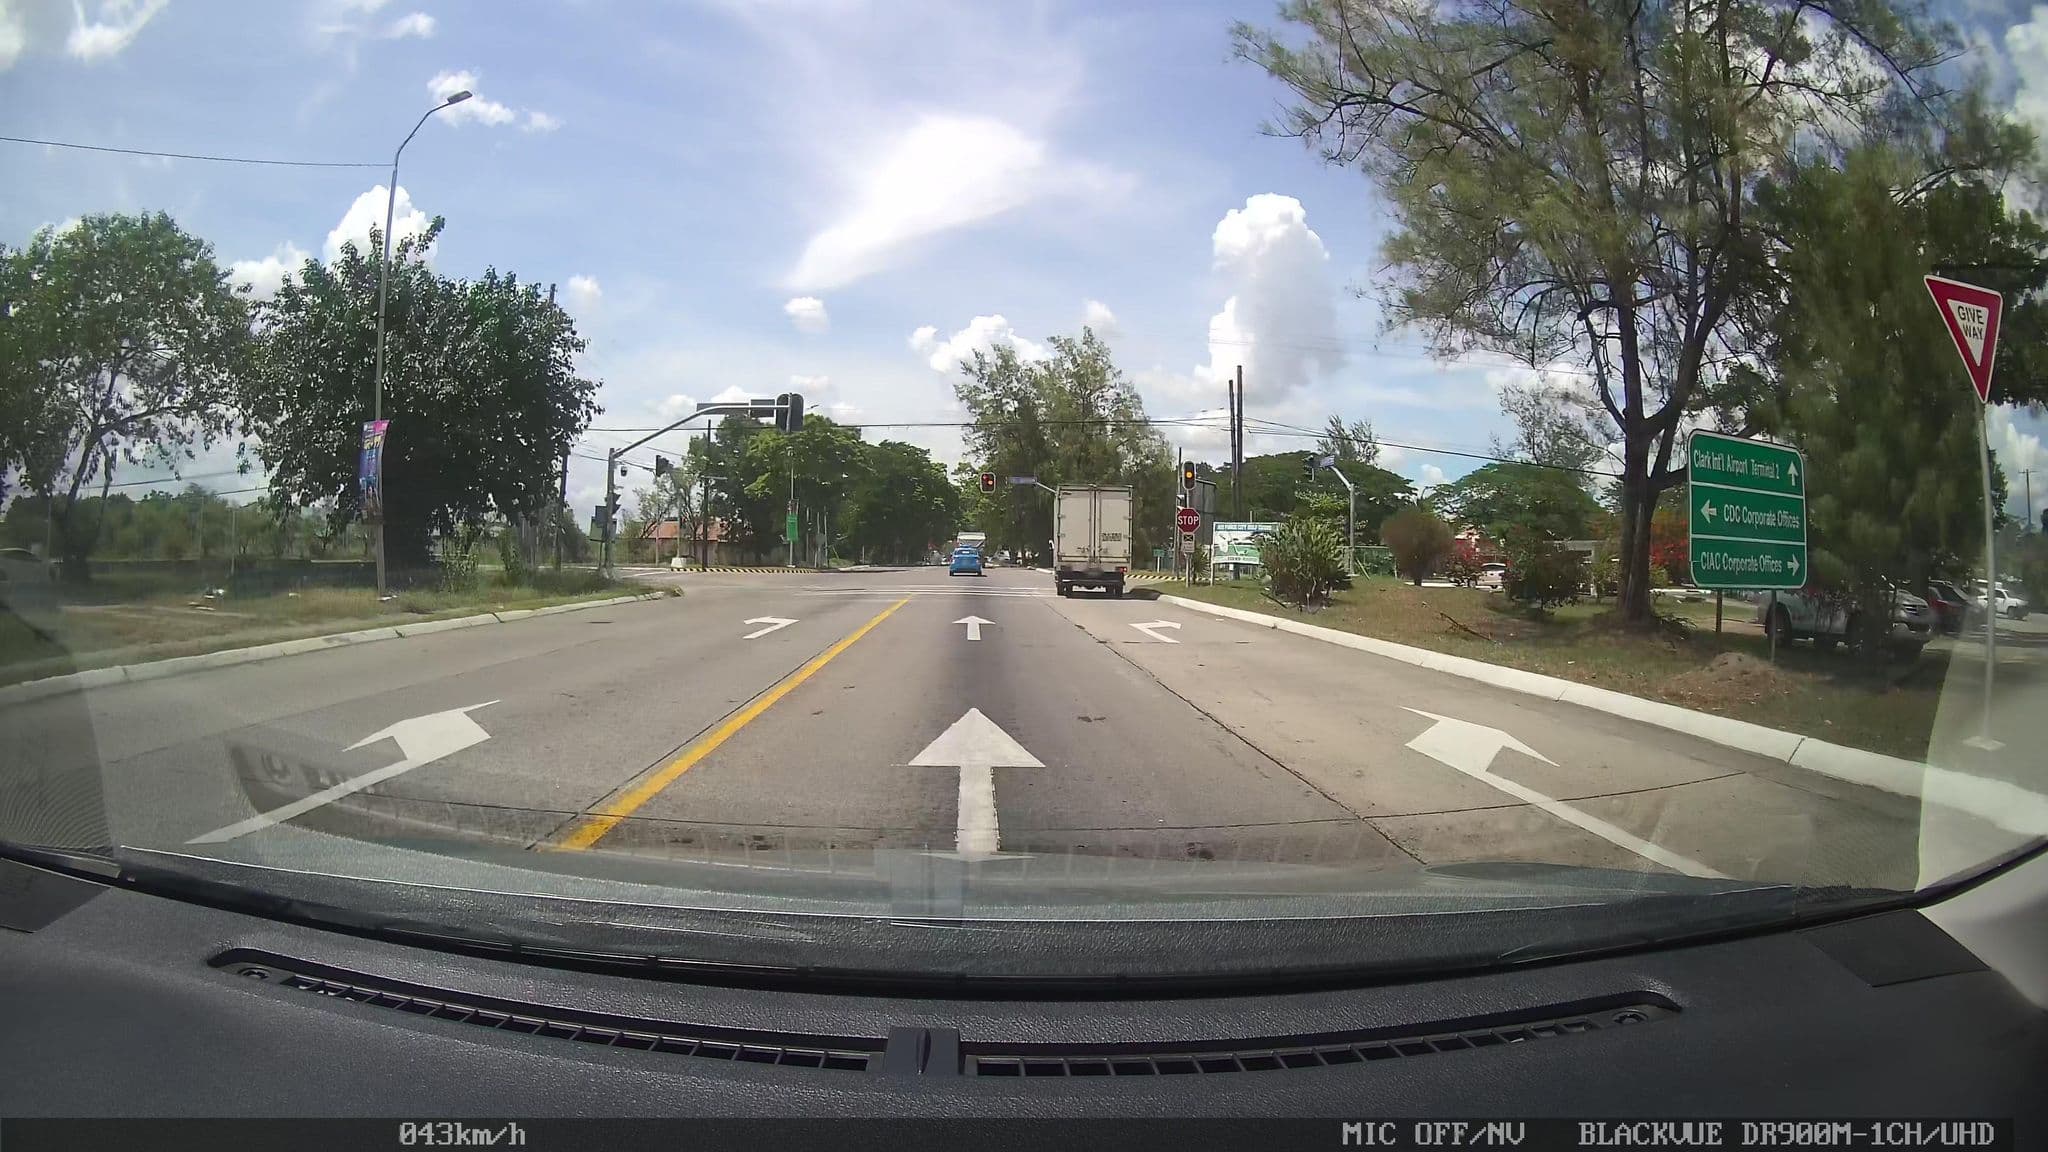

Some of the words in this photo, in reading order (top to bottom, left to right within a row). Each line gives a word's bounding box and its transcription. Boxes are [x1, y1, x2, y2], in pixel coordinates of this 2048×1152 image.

[1958, 306, 1984, 325] GIVE
[1963, 324, 1982, 340] WAY
[1693, 449, 1711, 470] Clark
[1726, 454, 1748, 475] Airport
[1750, 458, 1775, 479] Terminal
[1177, 515, 1199, 525] STOP
[1723, 503, 1741, 524] CDC
[1742, 505, 1776, 529] Corporate
[1777, 509, 1800, 529] Offices
[1701, 551, 1721, 570] CIAC
[1722, 552, 1758, 575] Corporate
[1758, 554, 1782, 573] Offices
